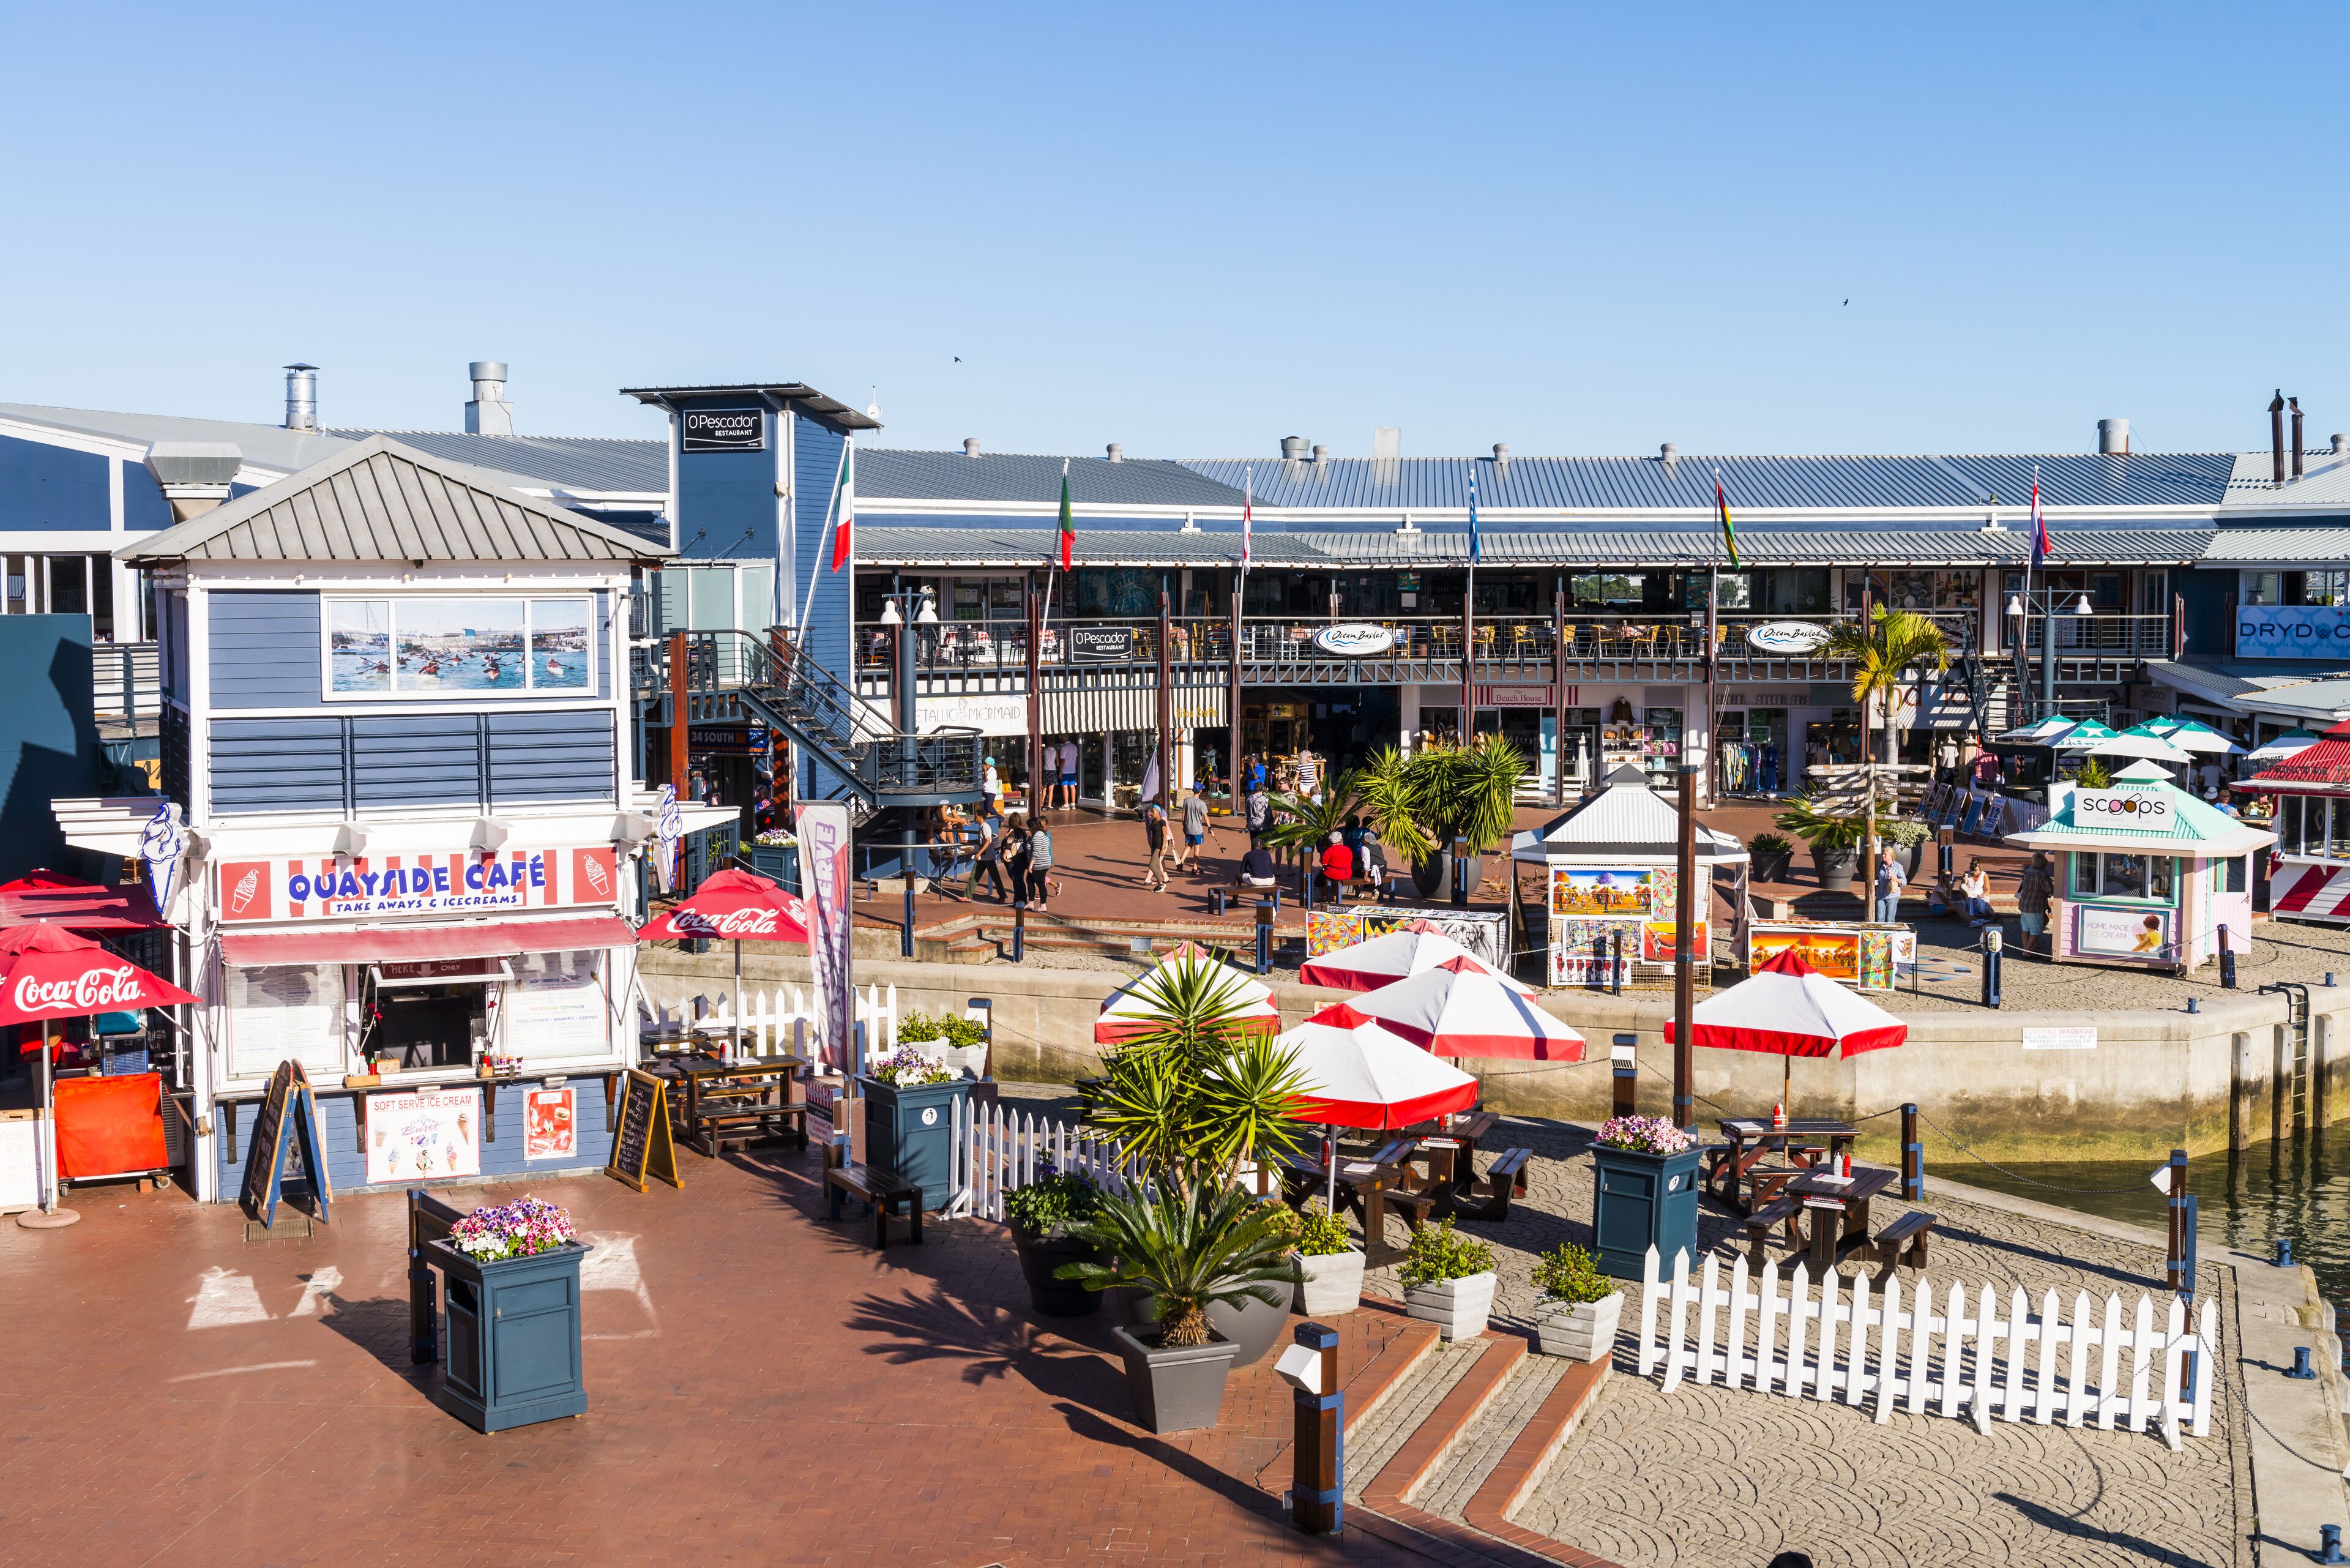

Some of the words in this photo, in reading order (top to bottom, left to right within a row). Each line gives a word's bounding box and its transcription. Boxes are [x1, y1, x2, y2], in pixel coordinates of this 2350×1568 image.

[688, 415, 698, 428] O
[699, 414, 758, 428] Pescador
[1076, 633, 1083, 644] O
[1084, 632, 1128, 644] Pescador
[1332, 630, 1357, 640] Ocean
[1356, 630, 1385, 640] Basket
[1764, 628, 1791, 638] Ocean
[1791, 629, 1821, 638] Basket
[915, 709, 958, 723] ETALLIC
[969, 706, 1021, 721] MERMAID
[1176, 707, 1193, 719] Bitou
[1196, 706, 1217, 718] Crafts
[692, 731, 703, 742] 34
[704, 732, 734, 743] SOUTH
[689, 755, 706, 764] ATM
[2262, 764, 2327, 775] SPRINGTIDE
[813, 821, 837, 911] SERVE
[288, 862, 450, 905] QUAYSIDE
[465, 854, 546, 891] CAFÉ
[336, 900, 371, 913] TAKE
[377, 899, 423, 911] AWAYS
[429, 899, 438, 908] &
[443, 894, 518, 909] ICECREAMS
[666, 908, 780, 934] Coca-Cola
[391, 963, 415, 974] HERE
[15, 966, 141, 1012] Coca-Cola
[374, 1101, 395, 1111] SOFT
[398, 1098, 425, 1110] SERVE
[427, 1097, 441, 1107] ICE
[443, 1095, 472, 1107] CREAM
[813, 1118, 826, 1127] Quayside
[813, 1125, 827, 1135] Customers
